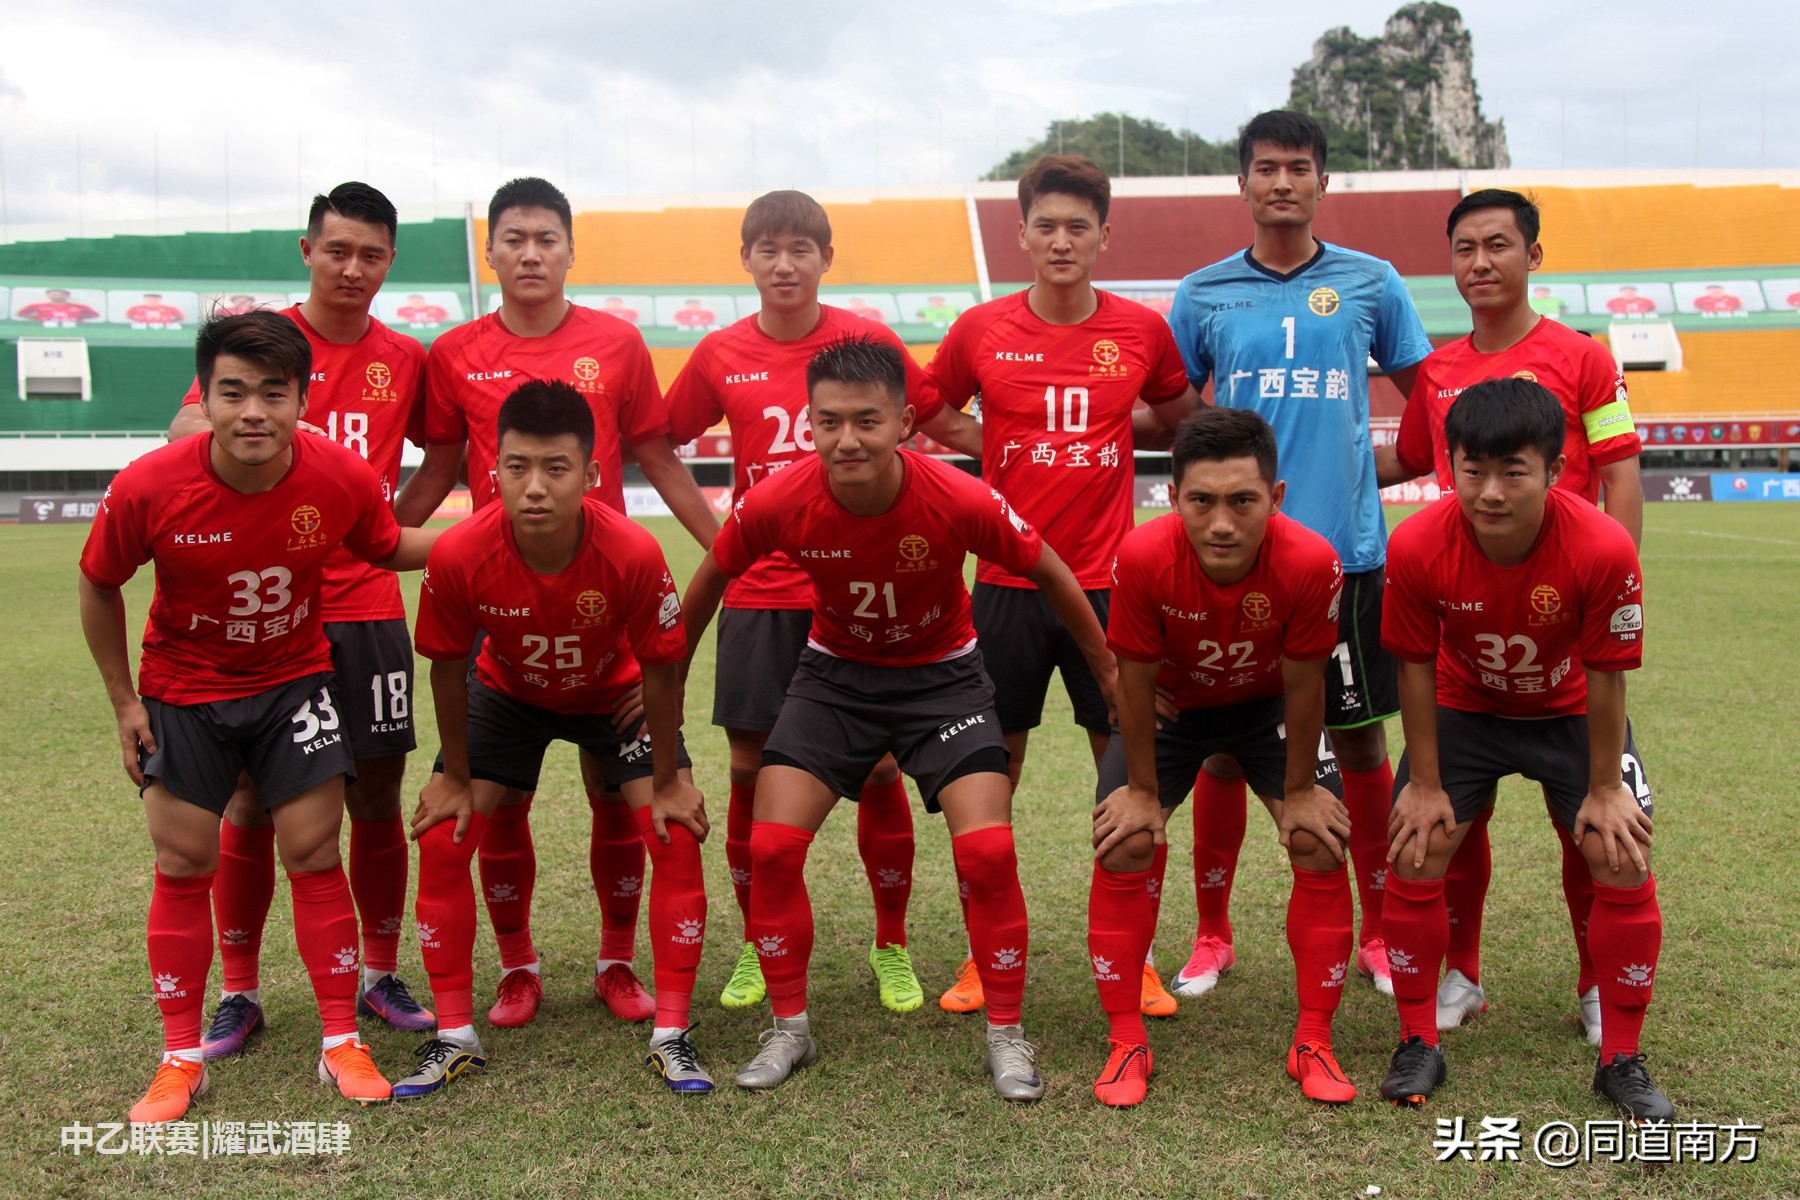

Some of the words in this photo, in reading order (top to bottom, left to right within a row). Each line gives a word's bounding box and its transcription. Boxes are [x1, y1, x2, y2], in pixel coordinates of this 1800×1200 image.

[1211, 301, 1253, 313] KELME
[1281, 317, 1295, 359] 1
[994, 352, 1044, 362] KELME
[467, 371, 512, 380] KELME
[726, 372, 769, 384] KELME
[1229, 368, 1349, 400] 广西宝韵
[1044, 386, 1089, 432] 10
[327, 411, 368, 459] 18
[1000, 441, 1120, 468] 广西宝韵
[174, 532, 232, 544] KELME
[801, 550, 851, 558] KELME
[227, 566, 292, 616] 33
[849, 581, 897, 618] 21
[189, 597, 310, 643] 广西宝韵
[479, 604, 530, 616] KELME
[1162, 604, 1207, 621] KELME
[522, 634, 583, 670] 25
[1197, 639, 1258, 672] 22
[1331, 641, 1354, 686] 1
[1474, 633, 1543, 673] 32
[371, 670, 408, 721] 18
[291, 686, 340, 743] 33
[371, 720, 409, 733] KELME
[940, 715, 985, 742] KELME
[303, 733, 342, 755] KELM
[626, 745, 652, 763] KEL
[1315, 763, 1338, 779] LME
[1621, 753, 1650, 798] 2
